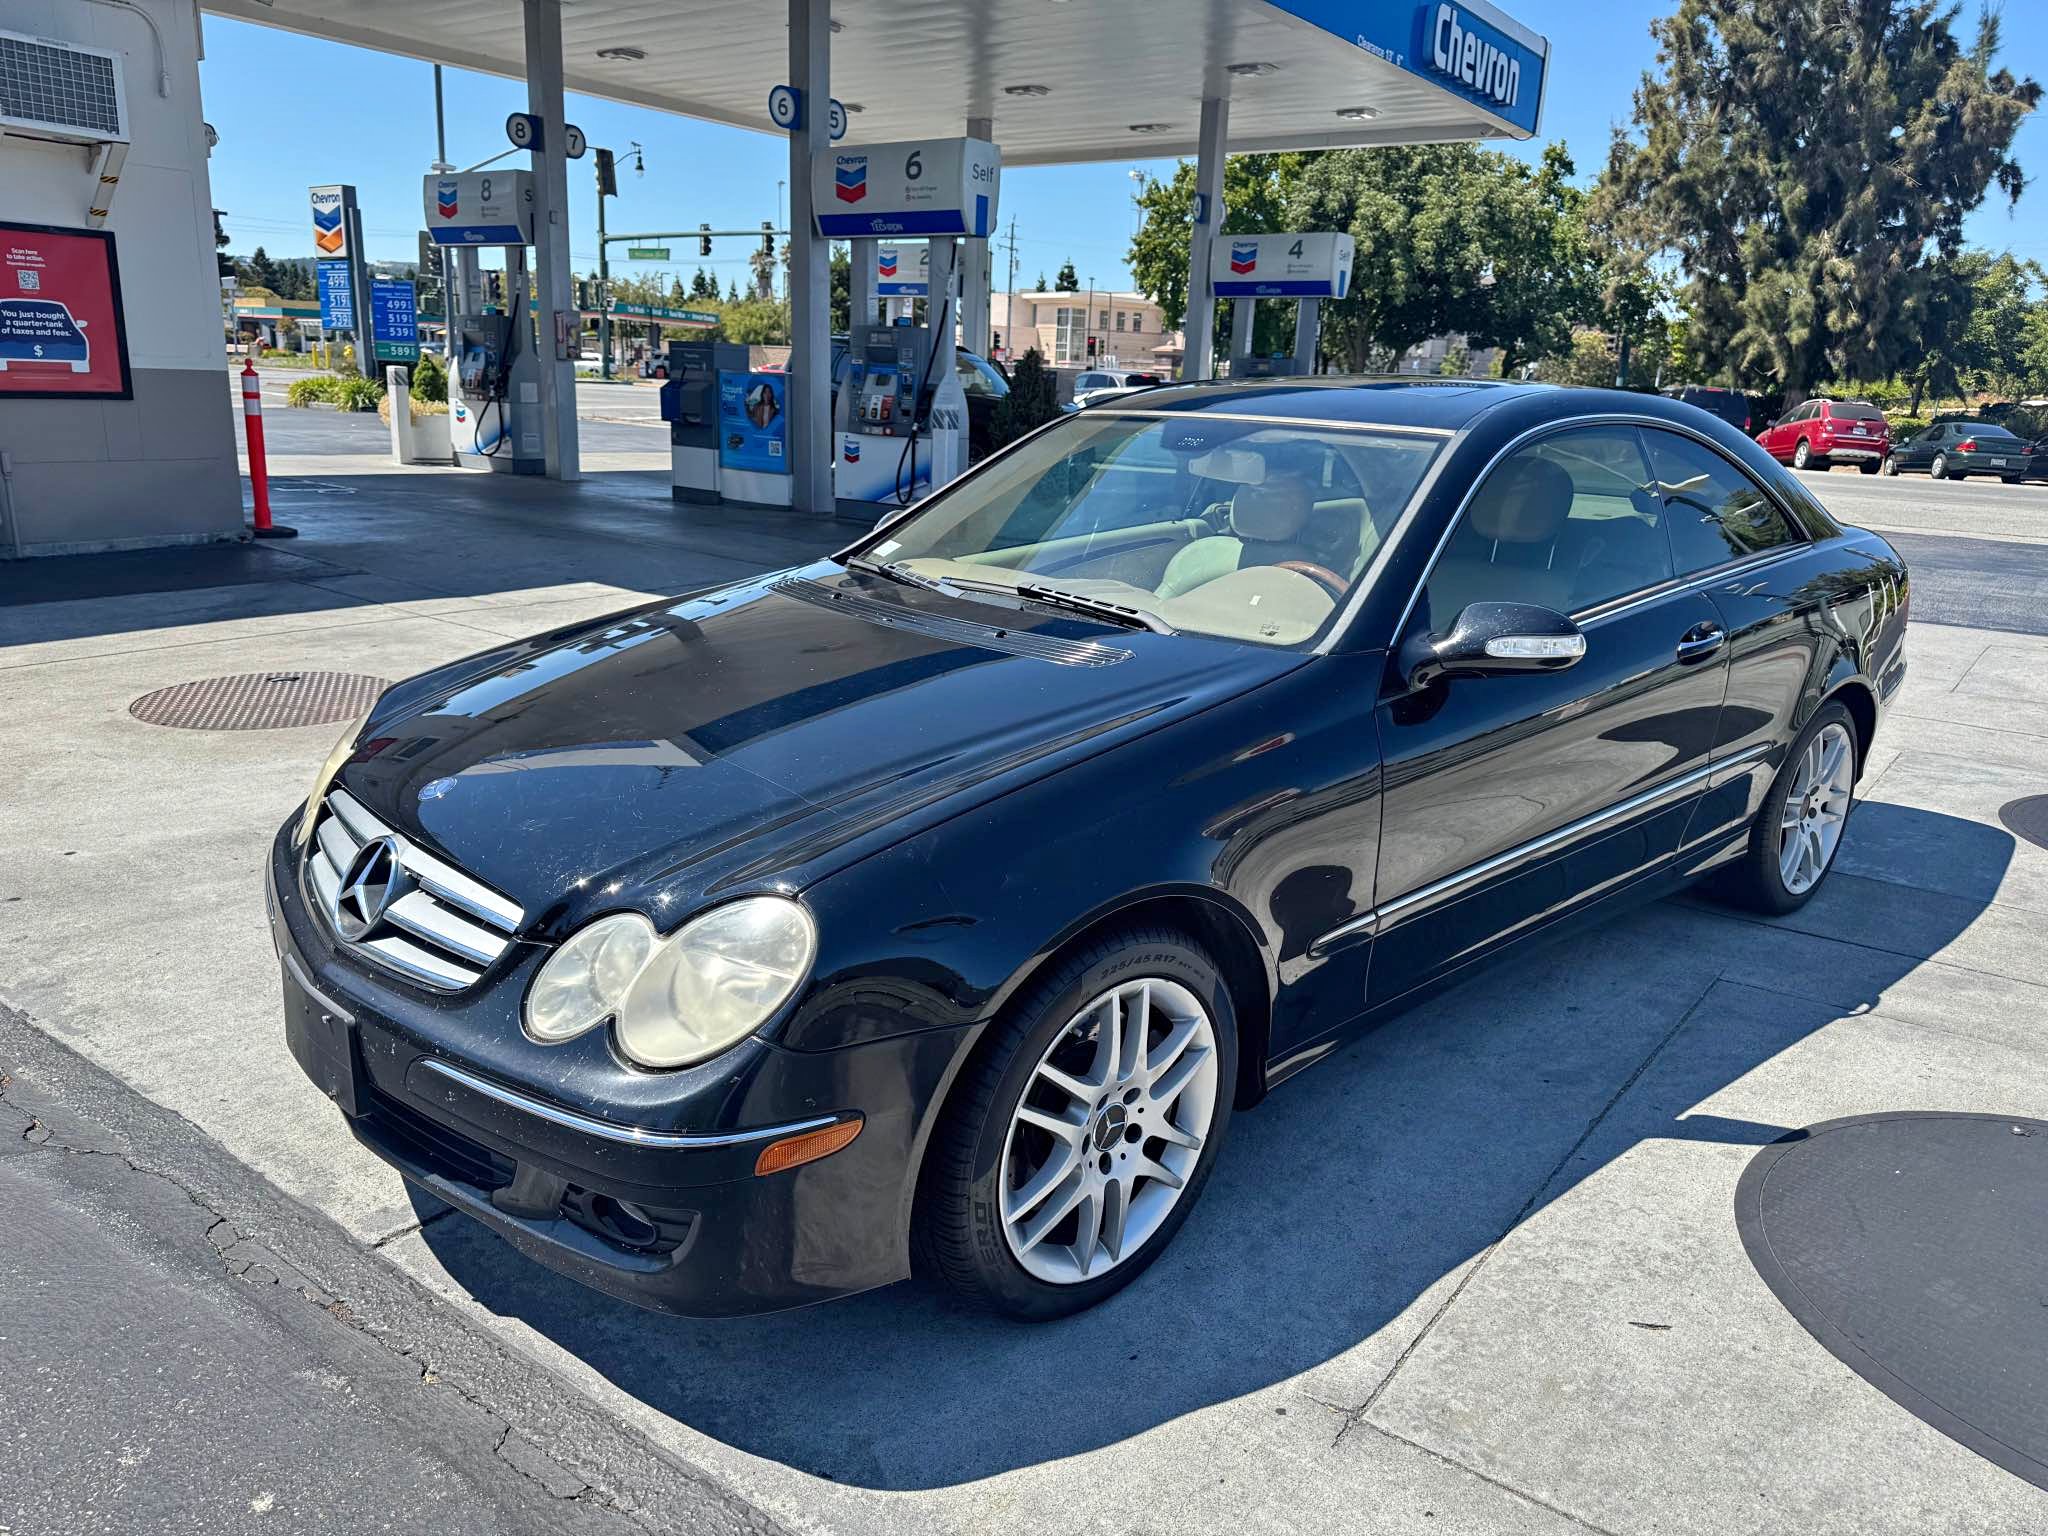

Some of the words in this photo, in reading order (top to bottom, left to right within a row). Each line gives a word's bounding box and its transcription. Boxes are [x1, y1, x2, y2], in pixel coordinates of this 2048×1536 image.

[1434, 3, 1520, 107] Chevron
[777, 97, 789, 116] 6
[829, 110, 839, 129] 5
[514, 122, 526, 139] 8
[569, 134, 578, 150] 7
[836, 156, 868, 165] Chevron
[905, 150, 922, 180] 6
[972, 163, 994, 183] Self
[311, 192, 341, 204] Chevron
[481, 178, 492, 202] 8
[1288, 239, 1304, 259] 4
[919, 249, 928, 266] 2
[386, 300, 407, 309] 499
[1, 309, 18, 317] You
[19, 310, 34, 319] just
[36, 311, 66, 320] bought
[388, 313, 408, 323] 519
[13, 320, 64, 328] quarter-tank
[389, 327, 409, 337] 539
[33, 344, 44, 358] $
[390, 346, 410, 356] 589
